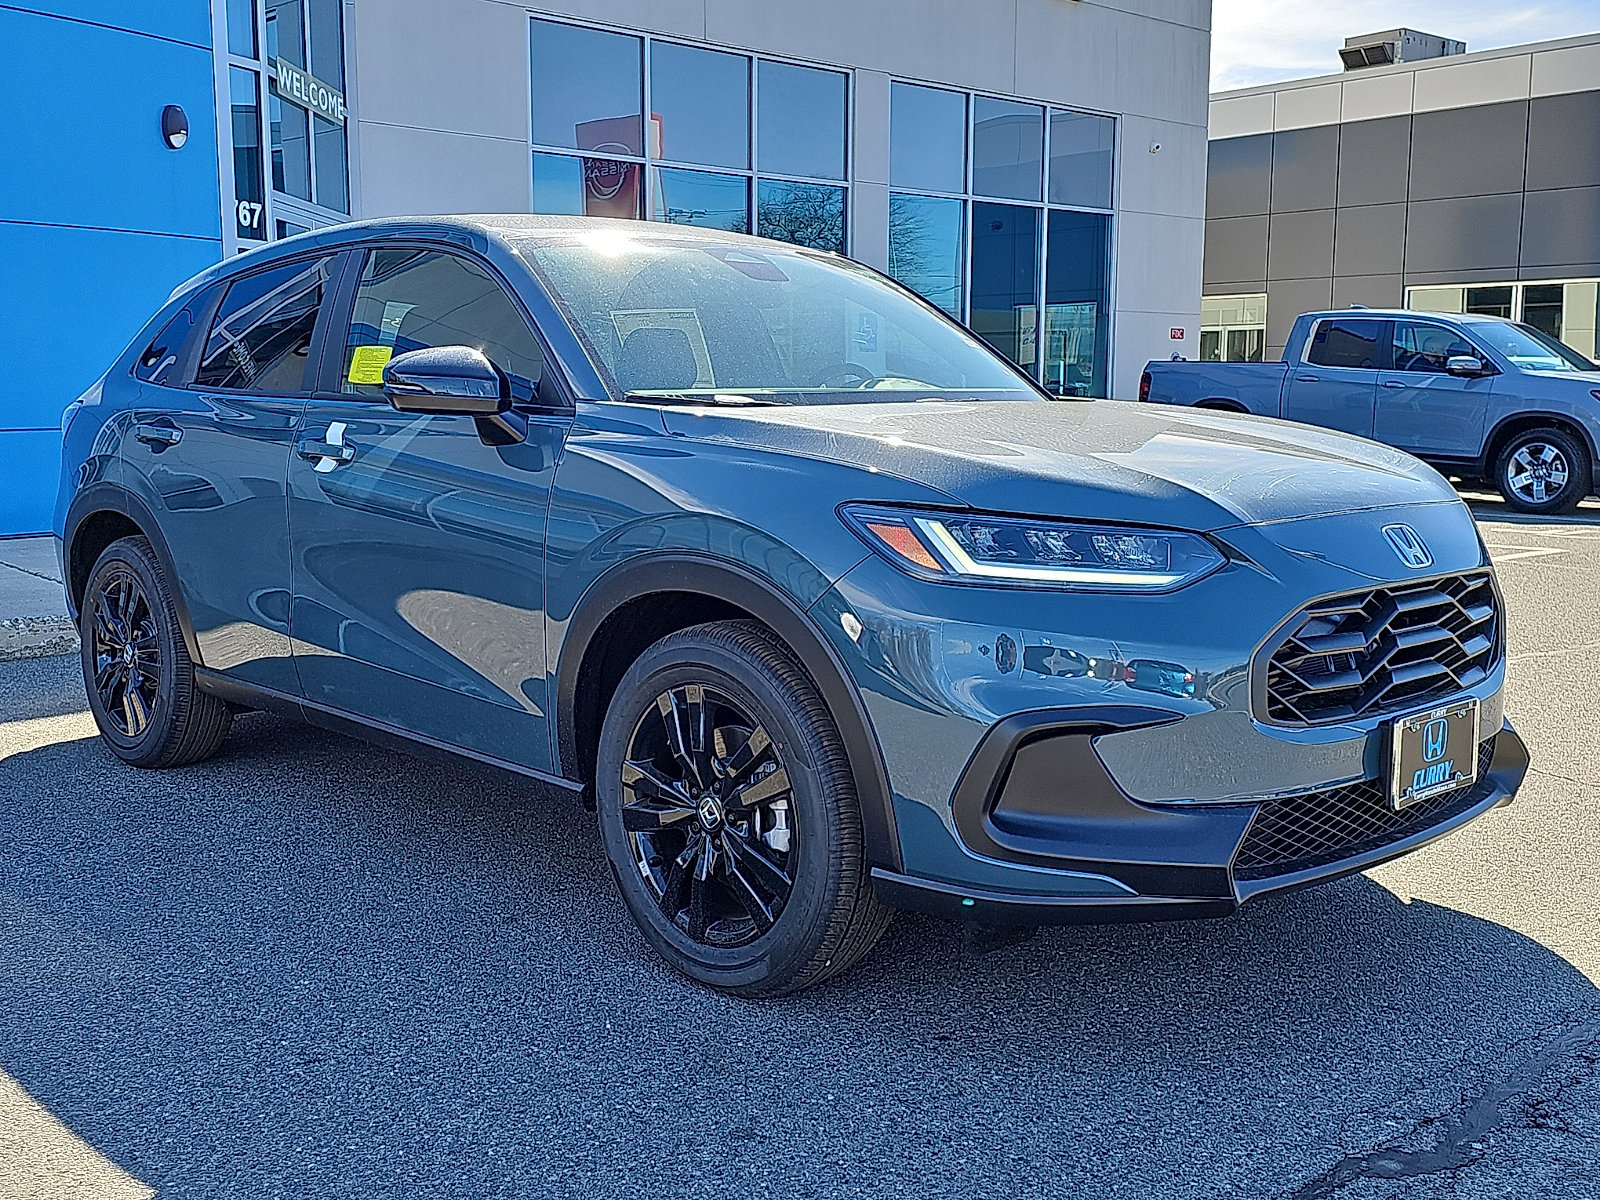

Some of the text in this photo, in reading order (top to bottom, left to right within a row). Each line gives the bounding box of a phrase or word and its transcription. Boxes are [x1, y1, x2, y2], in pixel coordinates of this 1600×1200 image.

[277, 63, 344, 120] WELCOME
[234, 200, 262, 228] 67
[1413, 760, 1454, 790] CURRY
